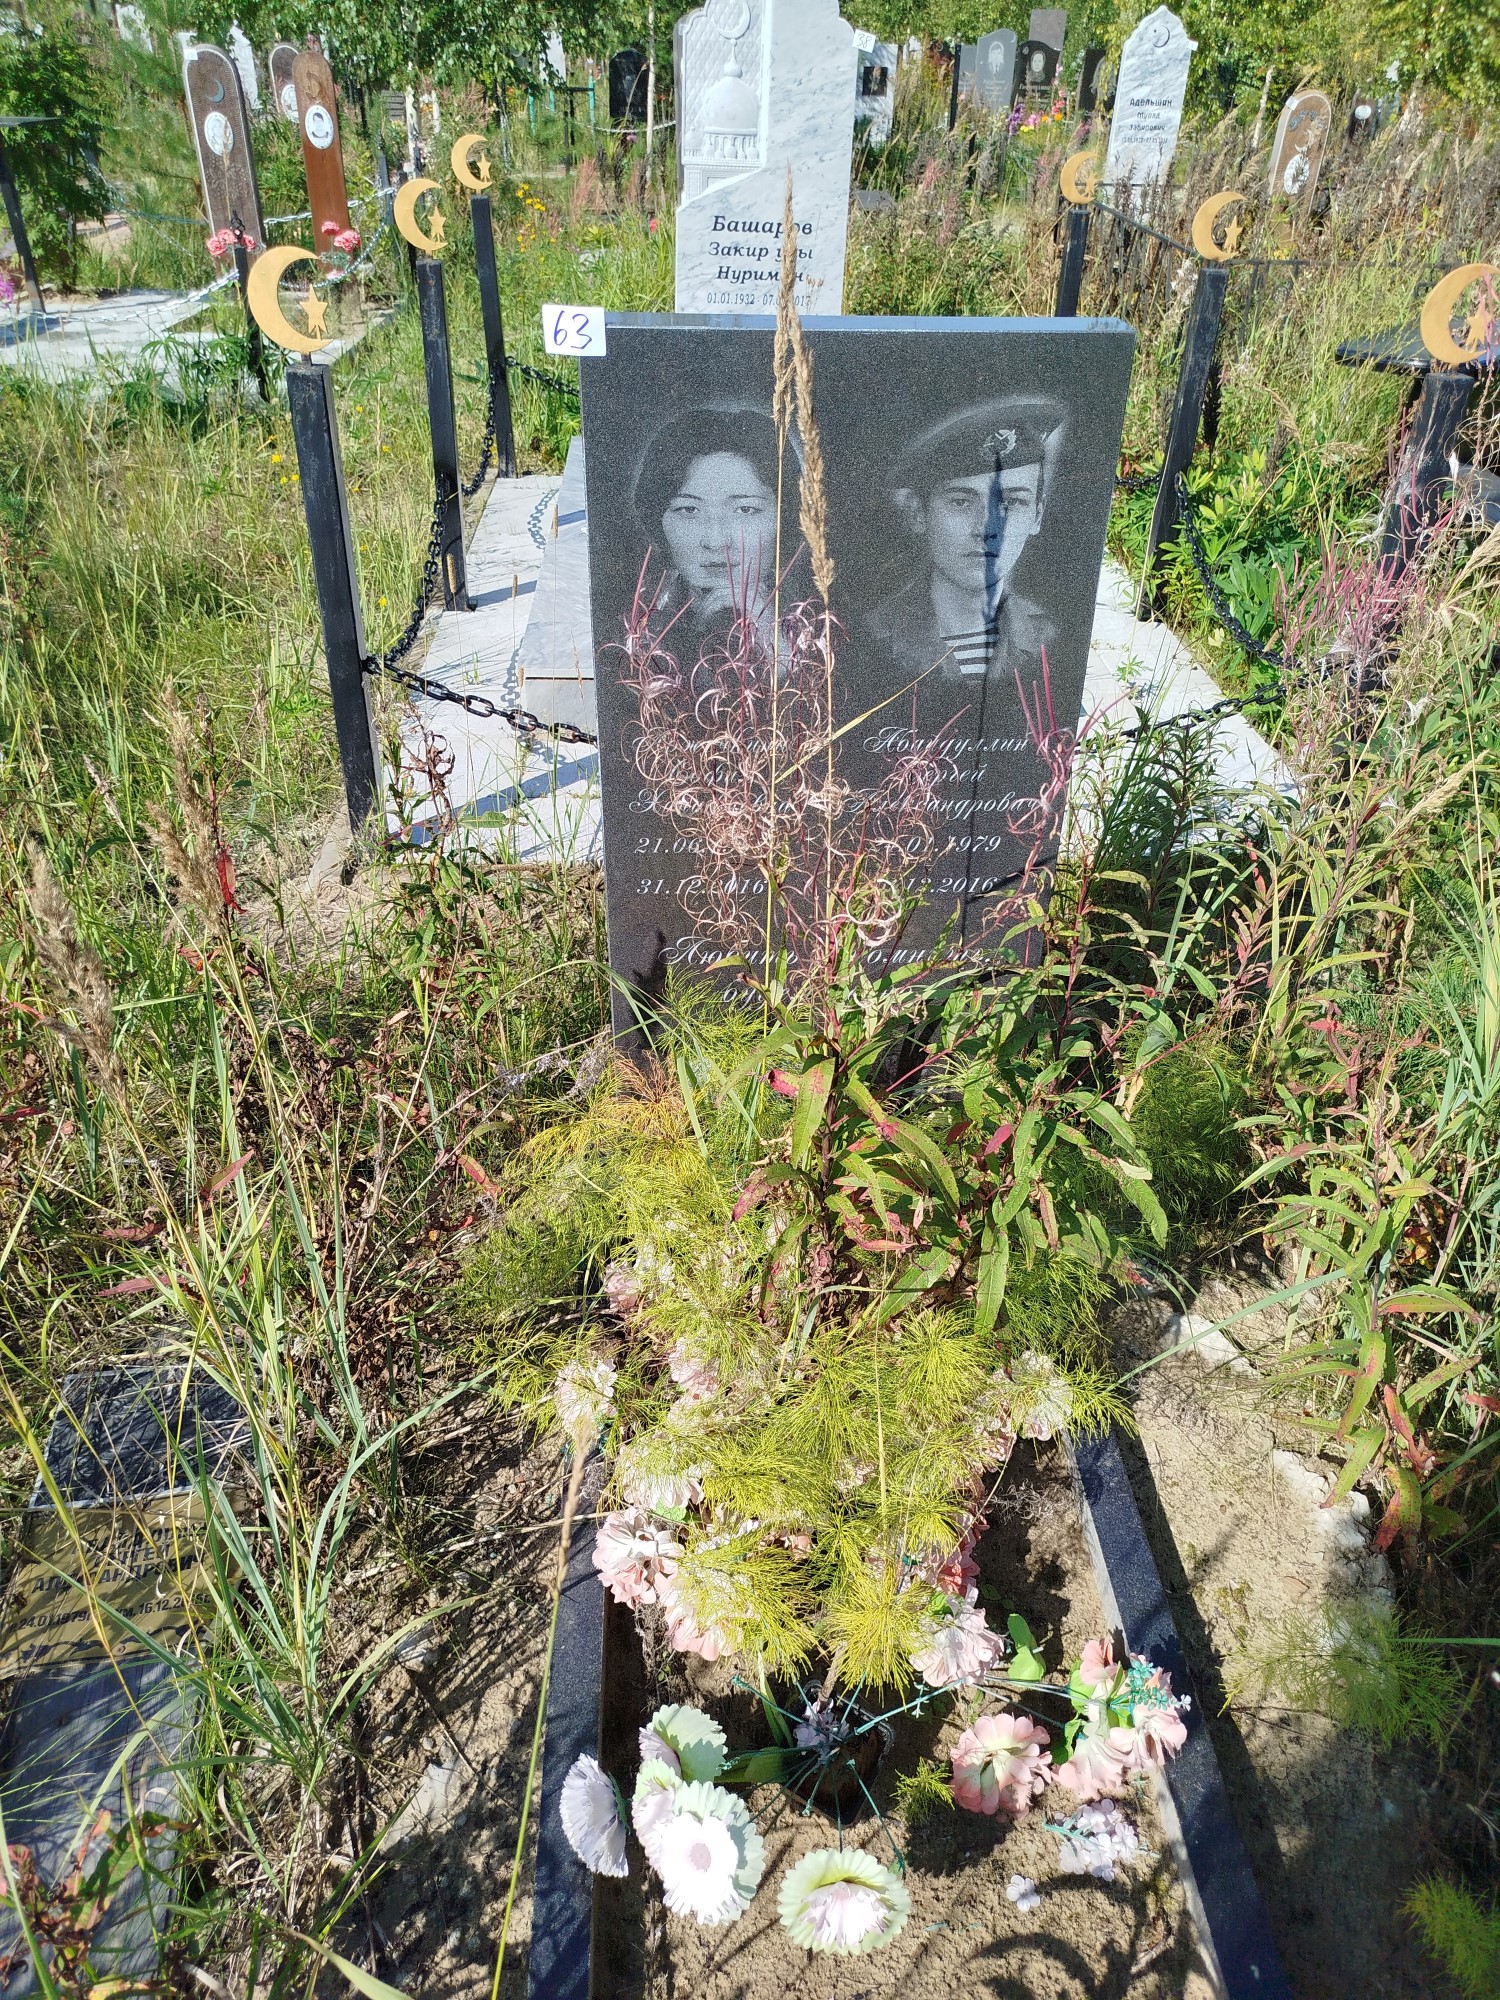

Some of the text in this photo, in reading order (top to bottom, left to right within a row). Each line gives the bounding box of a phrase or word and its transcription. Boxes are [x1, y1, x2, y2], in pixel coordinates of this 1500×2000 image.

[857, 33, 873, 49] 38
[708, 241, 813, 262] Закир уы
[716, 265, 804, 284] Нуримн
[553, 310, 592, 349] 63
[904, 763, 989, 784] ергей
[882, 835, 1001, 853] .01.1979
[880, 876, 998, 894] .12.2016
